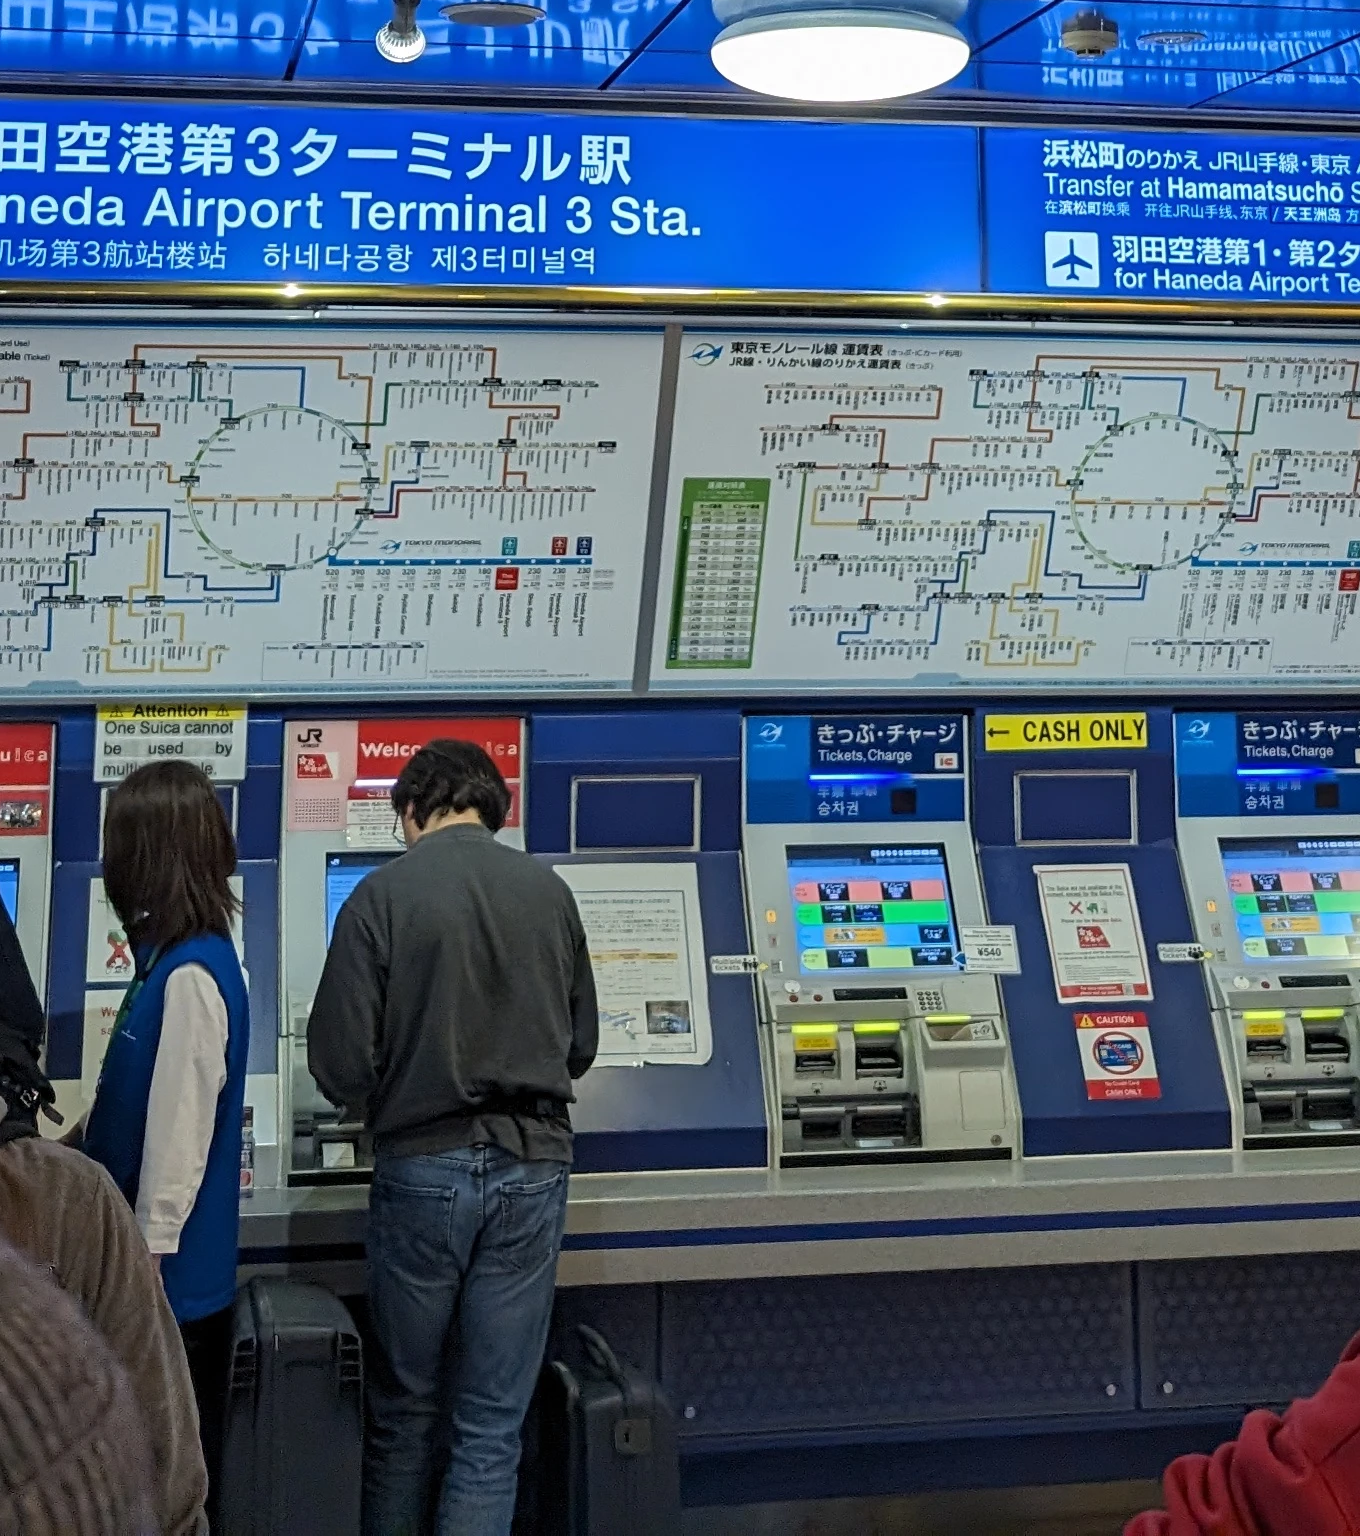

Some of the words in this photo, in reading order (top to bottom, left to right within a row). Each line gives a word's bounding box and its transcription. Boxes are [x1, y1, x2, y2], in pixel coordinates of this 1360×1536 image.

[1043, 139, 1201, 170] 浜松町のりかえ
[1043, 173, 1134, 197] Transfer
[1141, 178, 1160, 198] at
[1168, 177, 1343, 202] Hamamatsuchō
[143, 188, 323, 236] Airport
[341, 191, 546, 233] Terminal
[566, 196, 591, 233] 3
[611, 196, 700, 236] Sta.
[1045, 200, 1130, 217] 在滨松町换乘
[264, 243, 412, 272] 하네다공항
[431, 245, 594, 274] 제3터미널역
[1114, 267, 1146, 288] for
[1154, 268, 1243, 291] Haneda
[1249, 271, 1329, 296] Airport
[1023, 720, 1080, 742] CASH
[1090, 719, 1144, 741] ONLY
[1096, 1016, 1134, 1024] CAUTION
